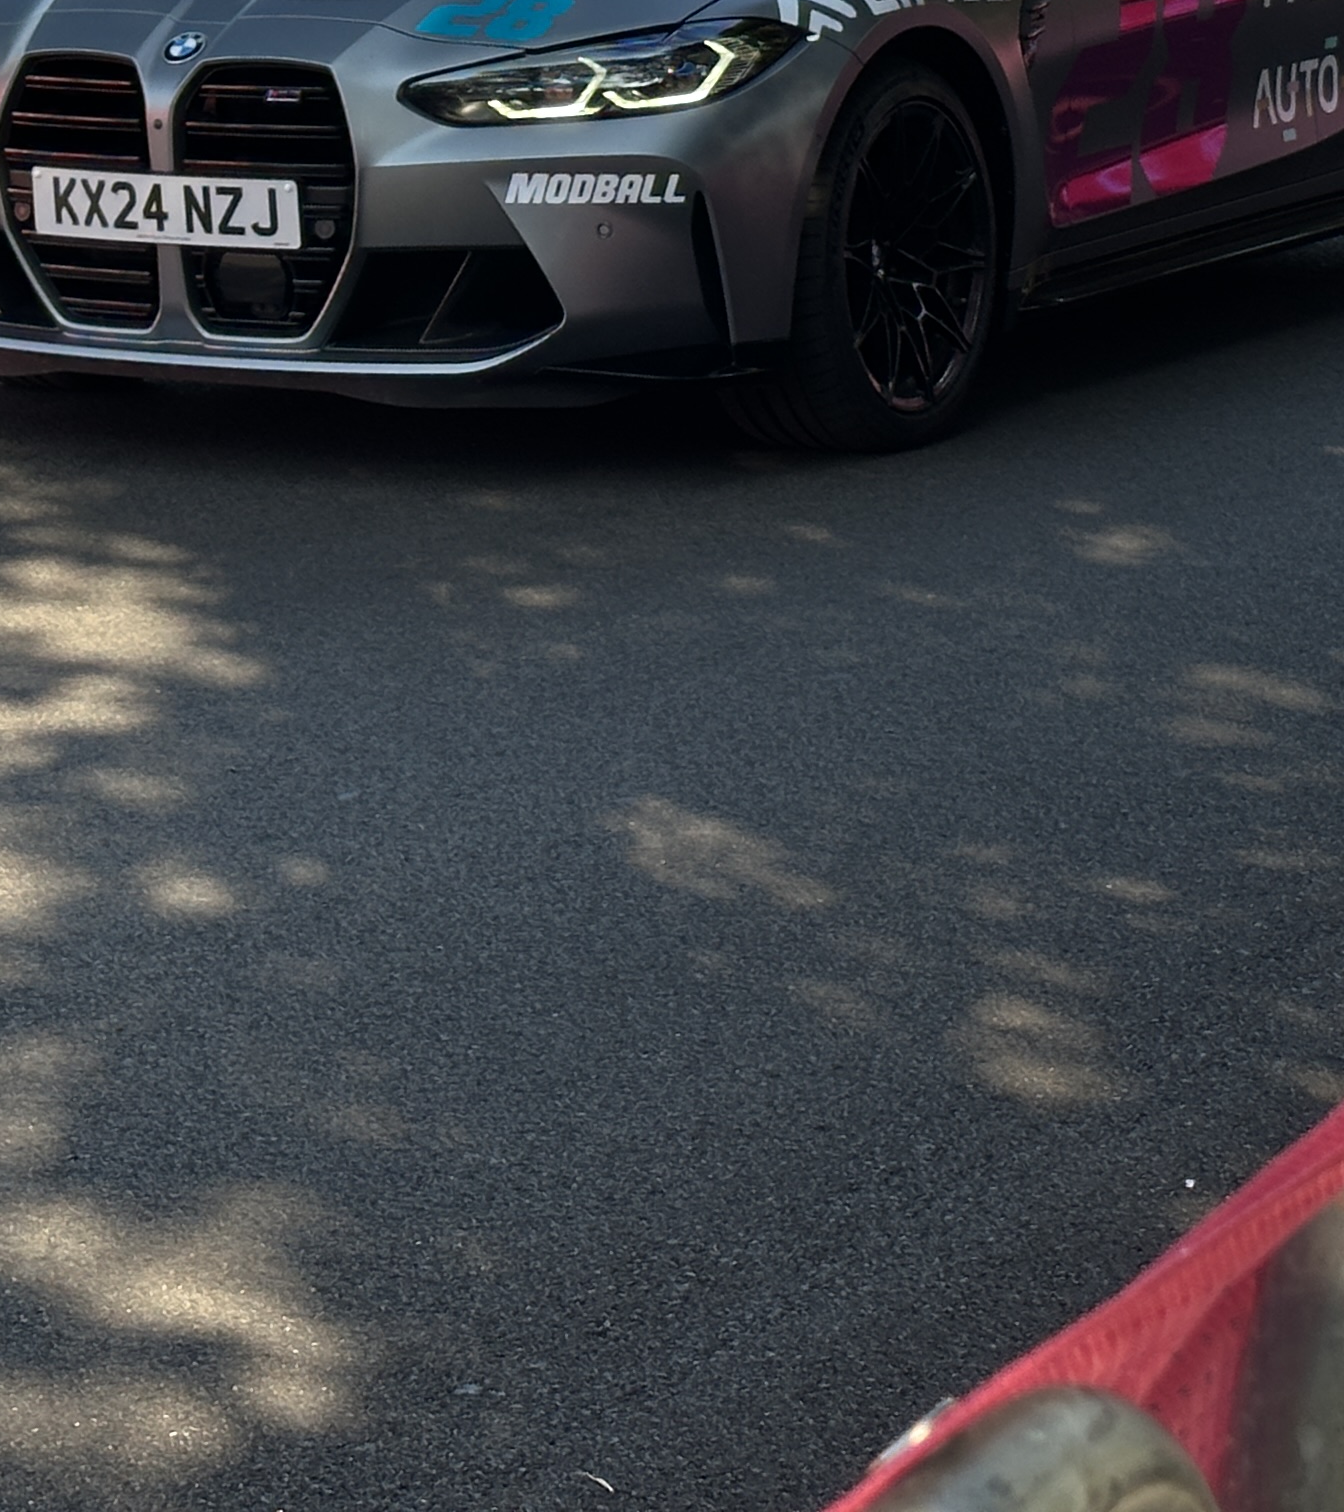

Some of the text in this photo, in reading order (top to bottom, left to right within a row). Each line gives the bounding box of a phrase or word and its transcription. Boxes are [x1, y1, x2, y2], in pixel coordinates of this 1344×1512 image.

[52, 176, 279, 237] KX24 NZJ
[505, 173, 685, 204] MODBALL
